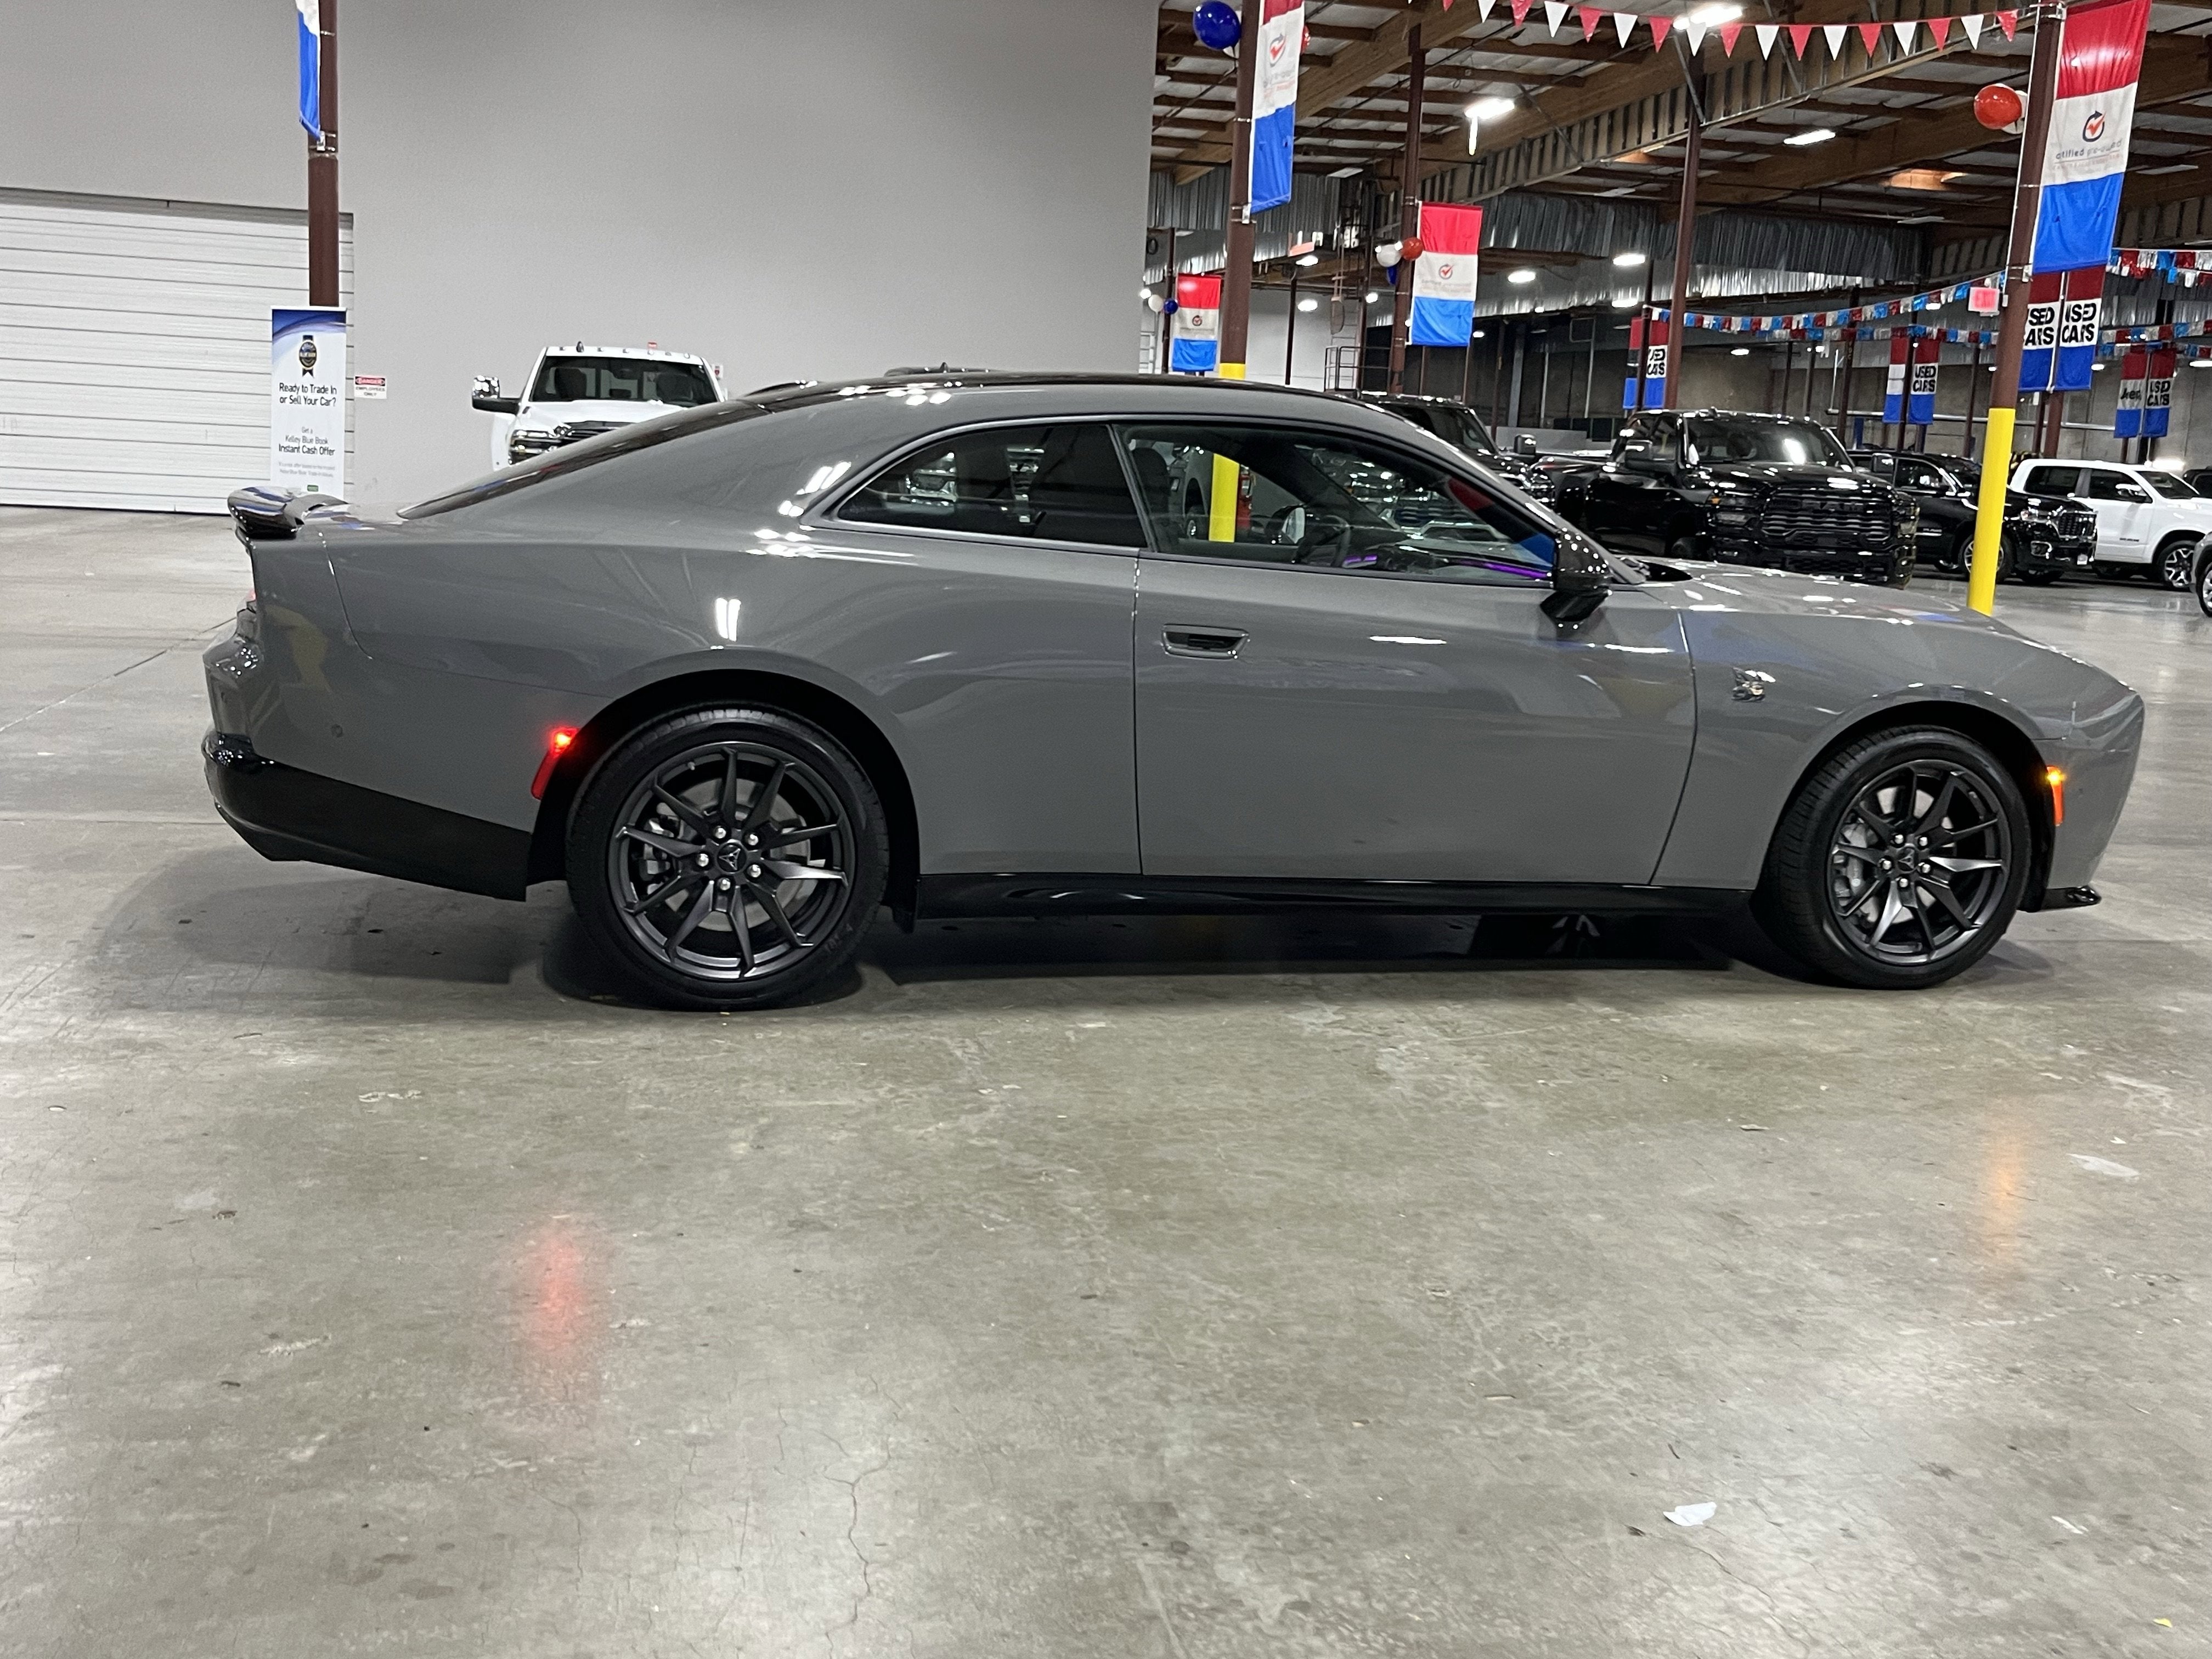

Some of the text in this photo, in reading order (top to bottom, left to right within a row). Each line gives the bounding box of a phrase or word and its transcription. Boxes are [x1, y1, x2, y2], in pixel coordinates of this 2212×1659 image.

[2029, 307, 2055, 326] SED
[2025, 326, 2054, 346] ARS
[279, 382, 337, 395] Ready to Trade In
[289, 395, 302, 404] Sell
[303, 396, 319, 405] Your
[320, 397, 336, 406] Car?
[279, 443, 335, 455] Instant Cash Offer
